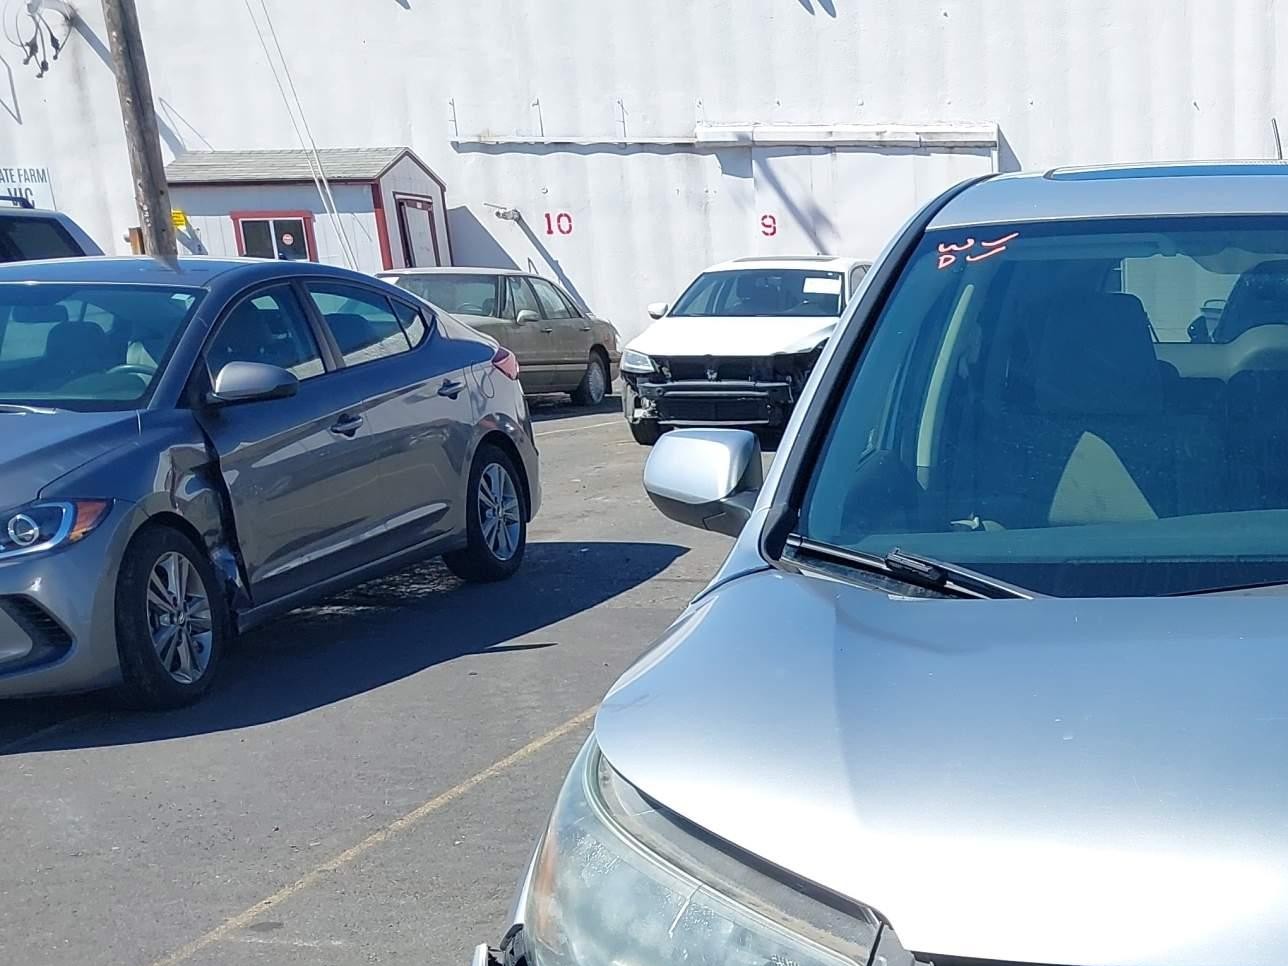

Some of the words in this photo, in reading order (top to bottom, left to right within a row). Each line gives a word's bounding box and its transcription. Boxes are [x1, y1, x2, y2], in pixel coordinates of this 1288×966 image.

[17, 168, 47, 183] FARM
[545, 213, 573, 235] 10
[761, 214, 778, 236] 9
